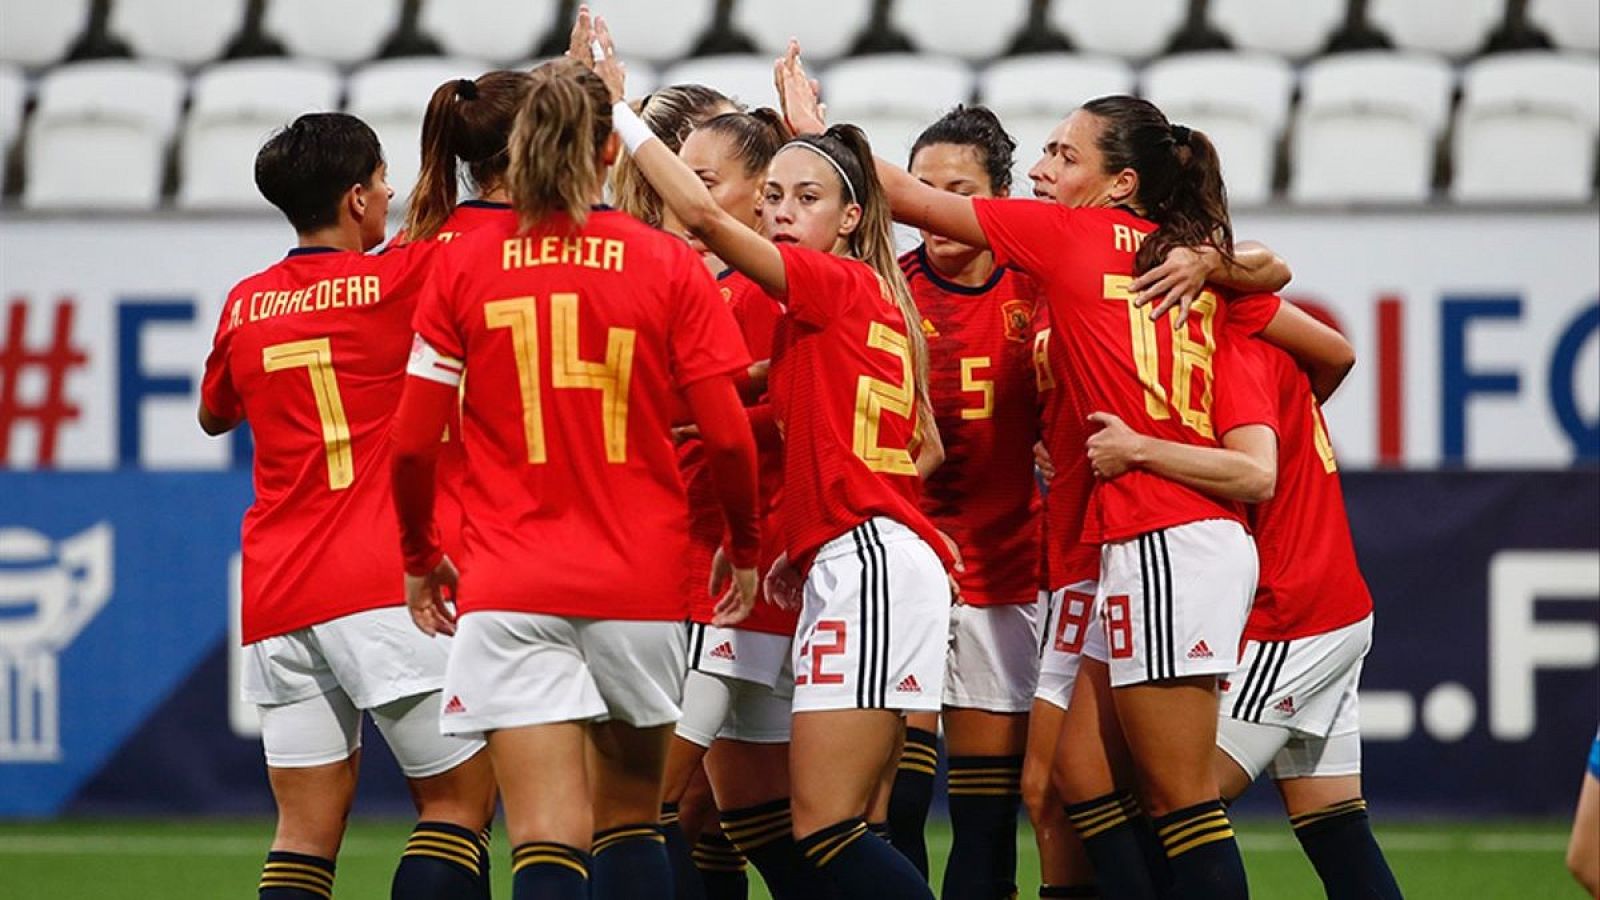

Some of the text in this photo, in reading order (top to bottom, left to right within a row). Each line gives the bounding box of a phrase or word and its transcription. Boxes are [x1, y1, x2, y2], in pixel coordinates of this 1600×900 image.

[262, 337, 354, 490] 7
[484, 293, 637, 464] 14
[853, 320, 922, 477] 2
[960, 357, 995, 420] 5
[1103, 274, 1218, 441] 18
[1054, 590, 1095, 655] 8
[1103, 595, 1133, 659] 8
